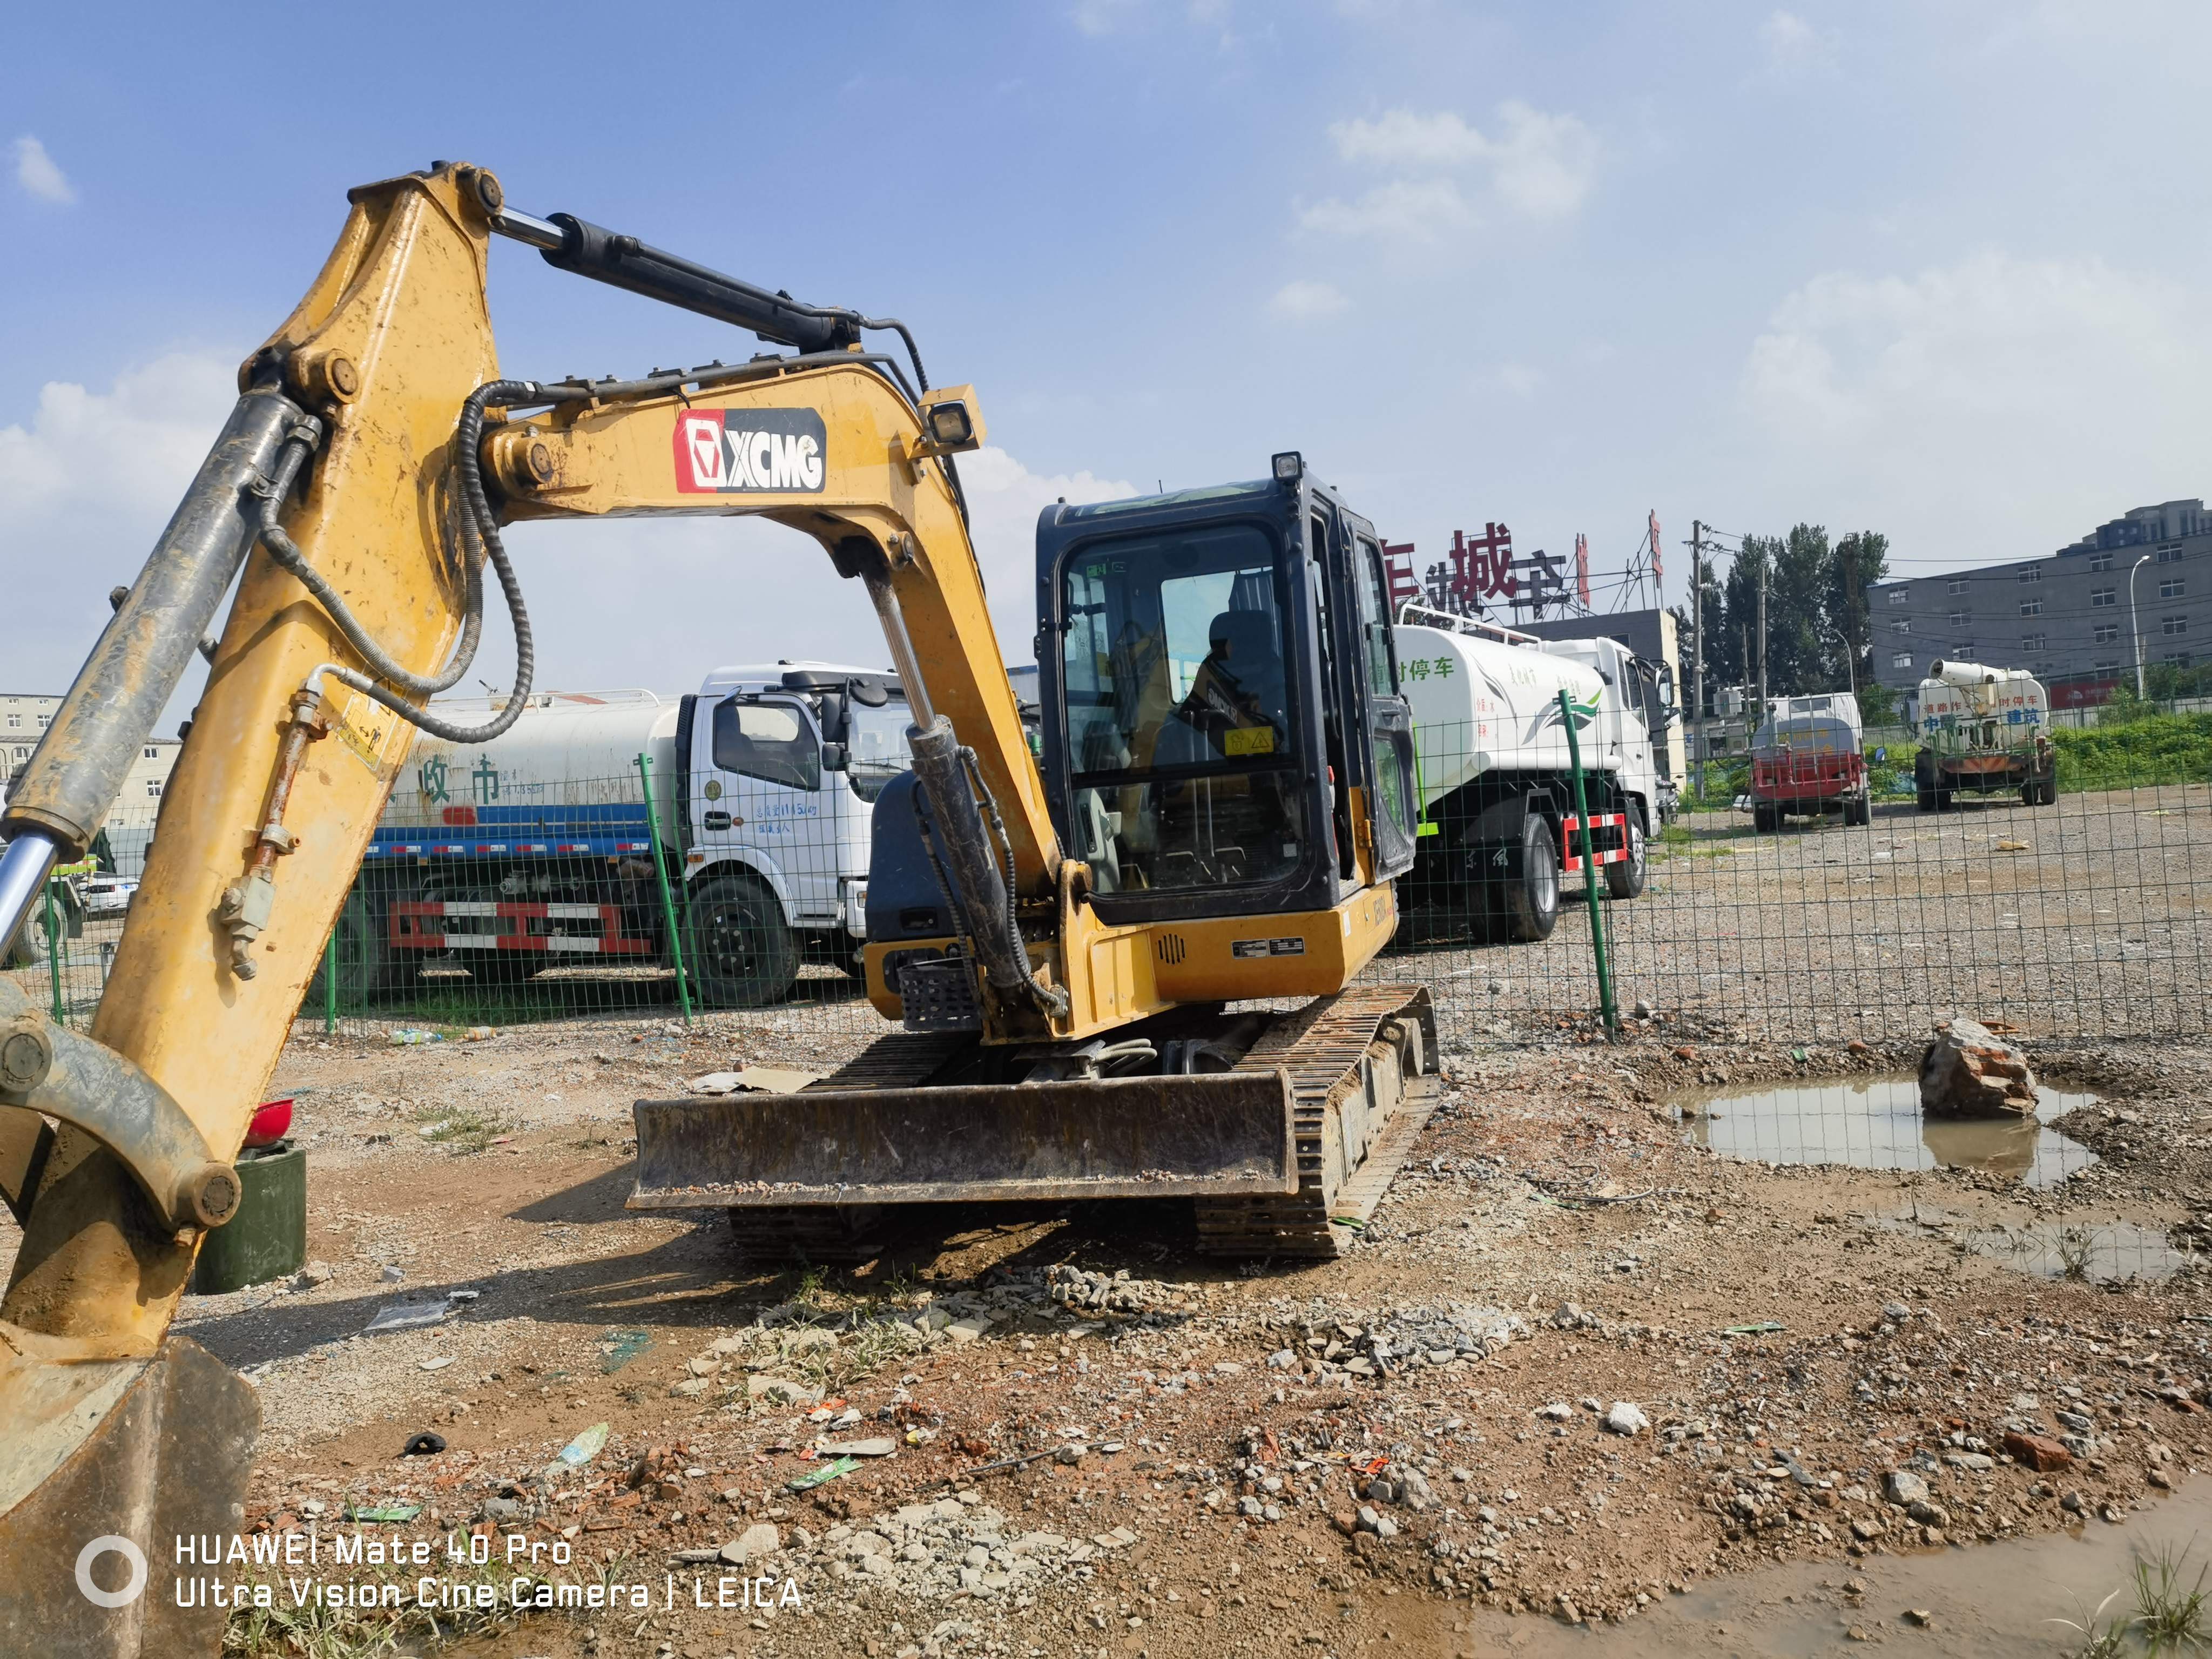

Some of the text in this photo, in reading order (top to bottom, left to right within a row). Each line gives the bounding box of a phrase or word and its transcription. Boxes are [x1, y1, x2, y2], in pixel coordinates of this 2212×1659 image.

[725, 430, 822, 489] XCMG
[1923, 695, 2038, 713] 道路作 时停车
[2006, 707, 2040, 724] 建筑
